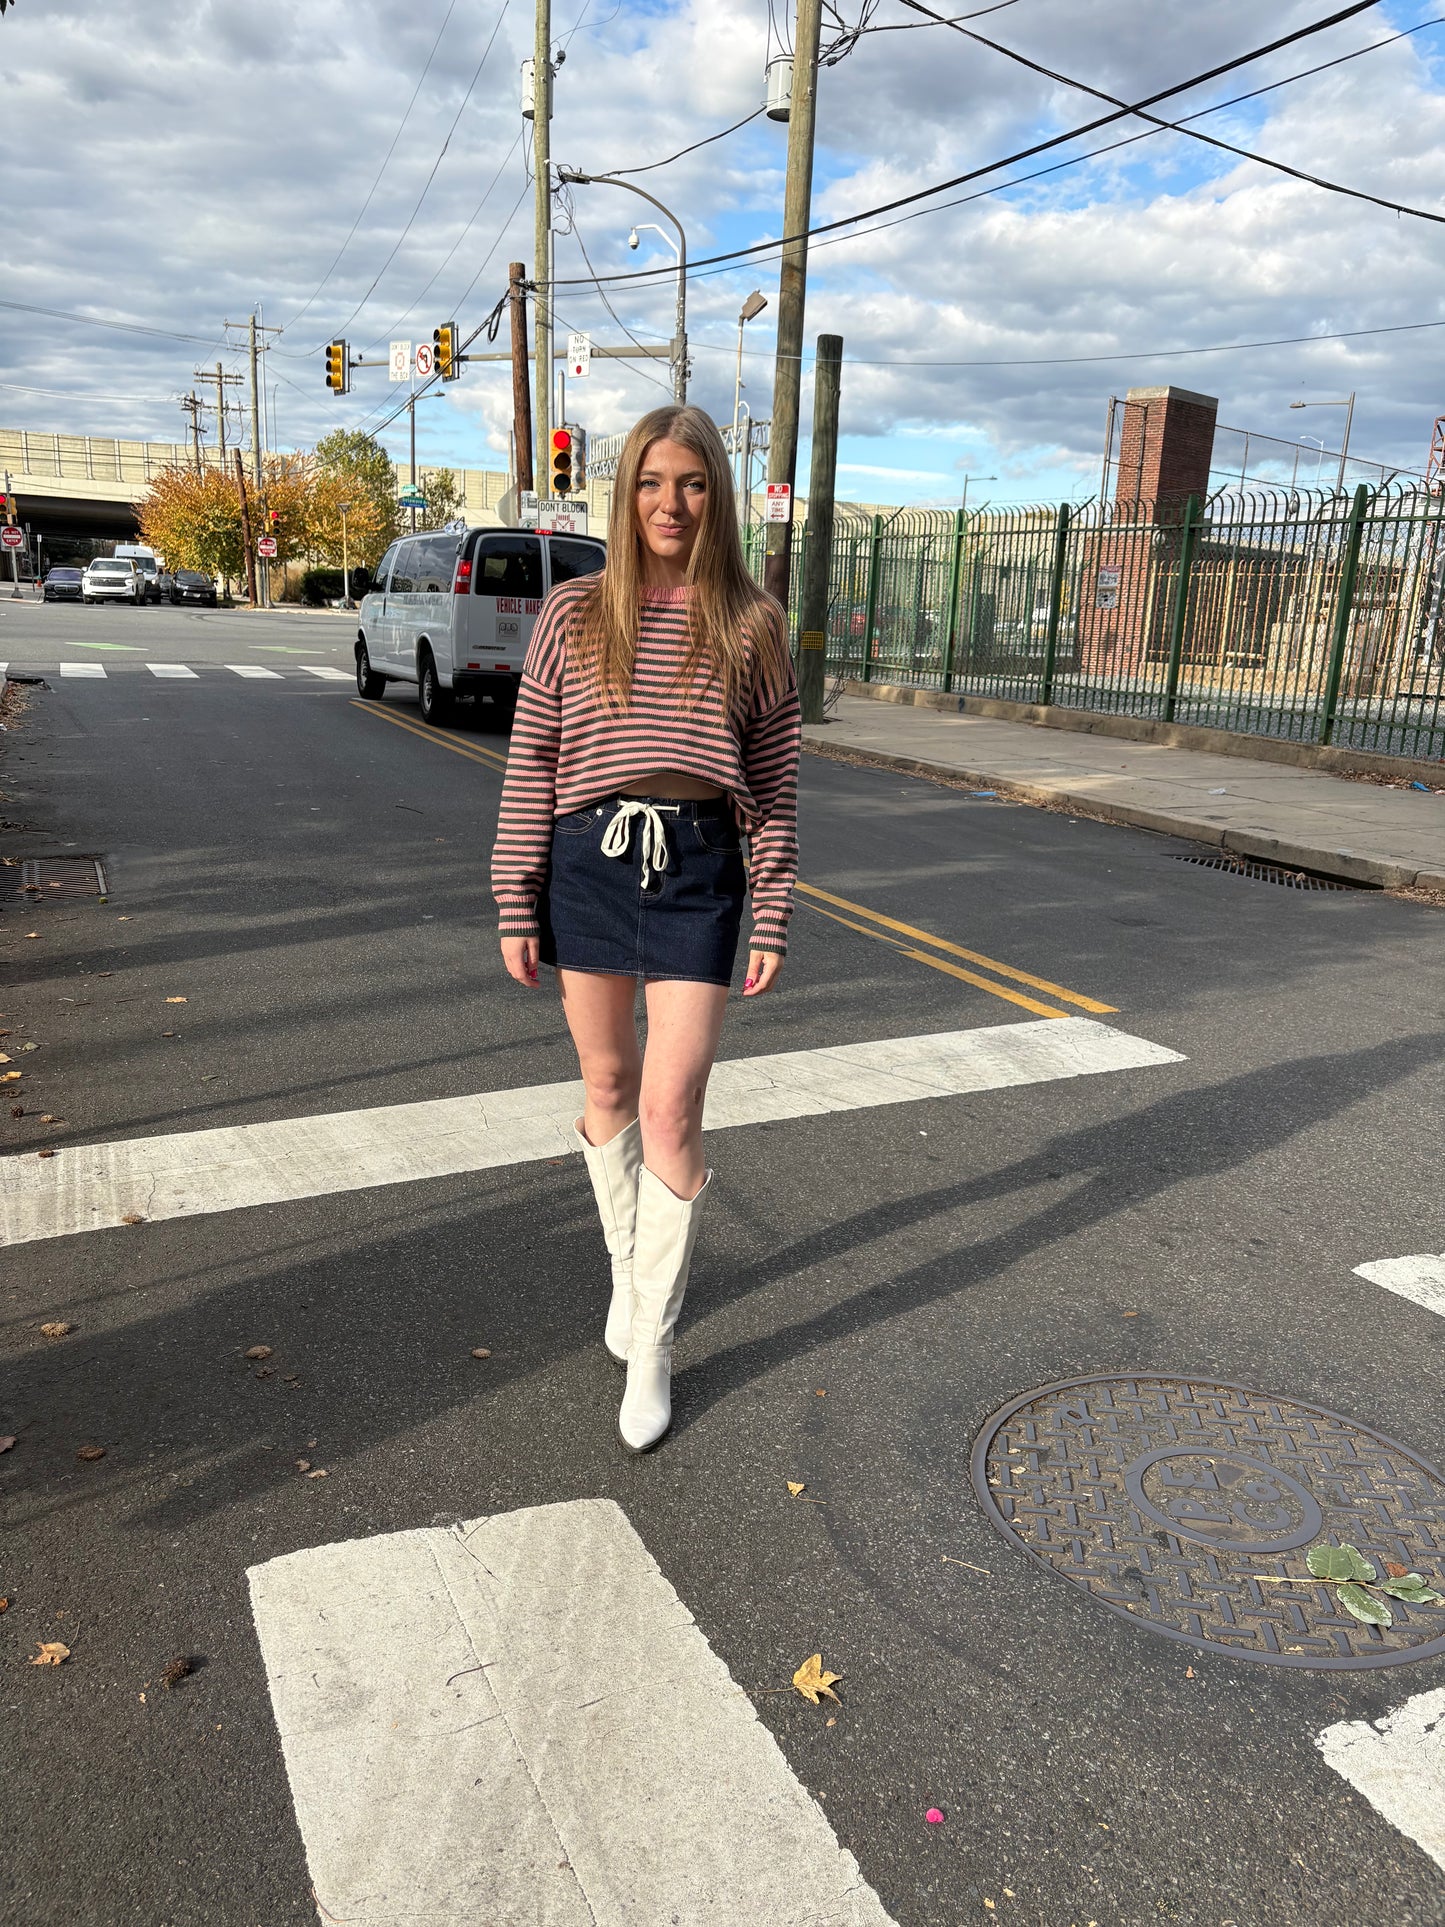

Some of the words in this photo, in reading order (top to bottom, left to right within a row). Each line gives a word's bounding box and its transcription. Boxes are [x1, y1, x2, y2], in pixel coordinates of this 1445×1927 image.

[574, 335, 584, 344] NO
[572, 346, 586, 354] TURN
[569, 356, 577, 364] ON
[579, 354, 589, 363] RED
[774, 485, 784, 494] NO
[562, 503, 585, 514] BLOCK
[496, 597, 522, 614] VEHICLE
